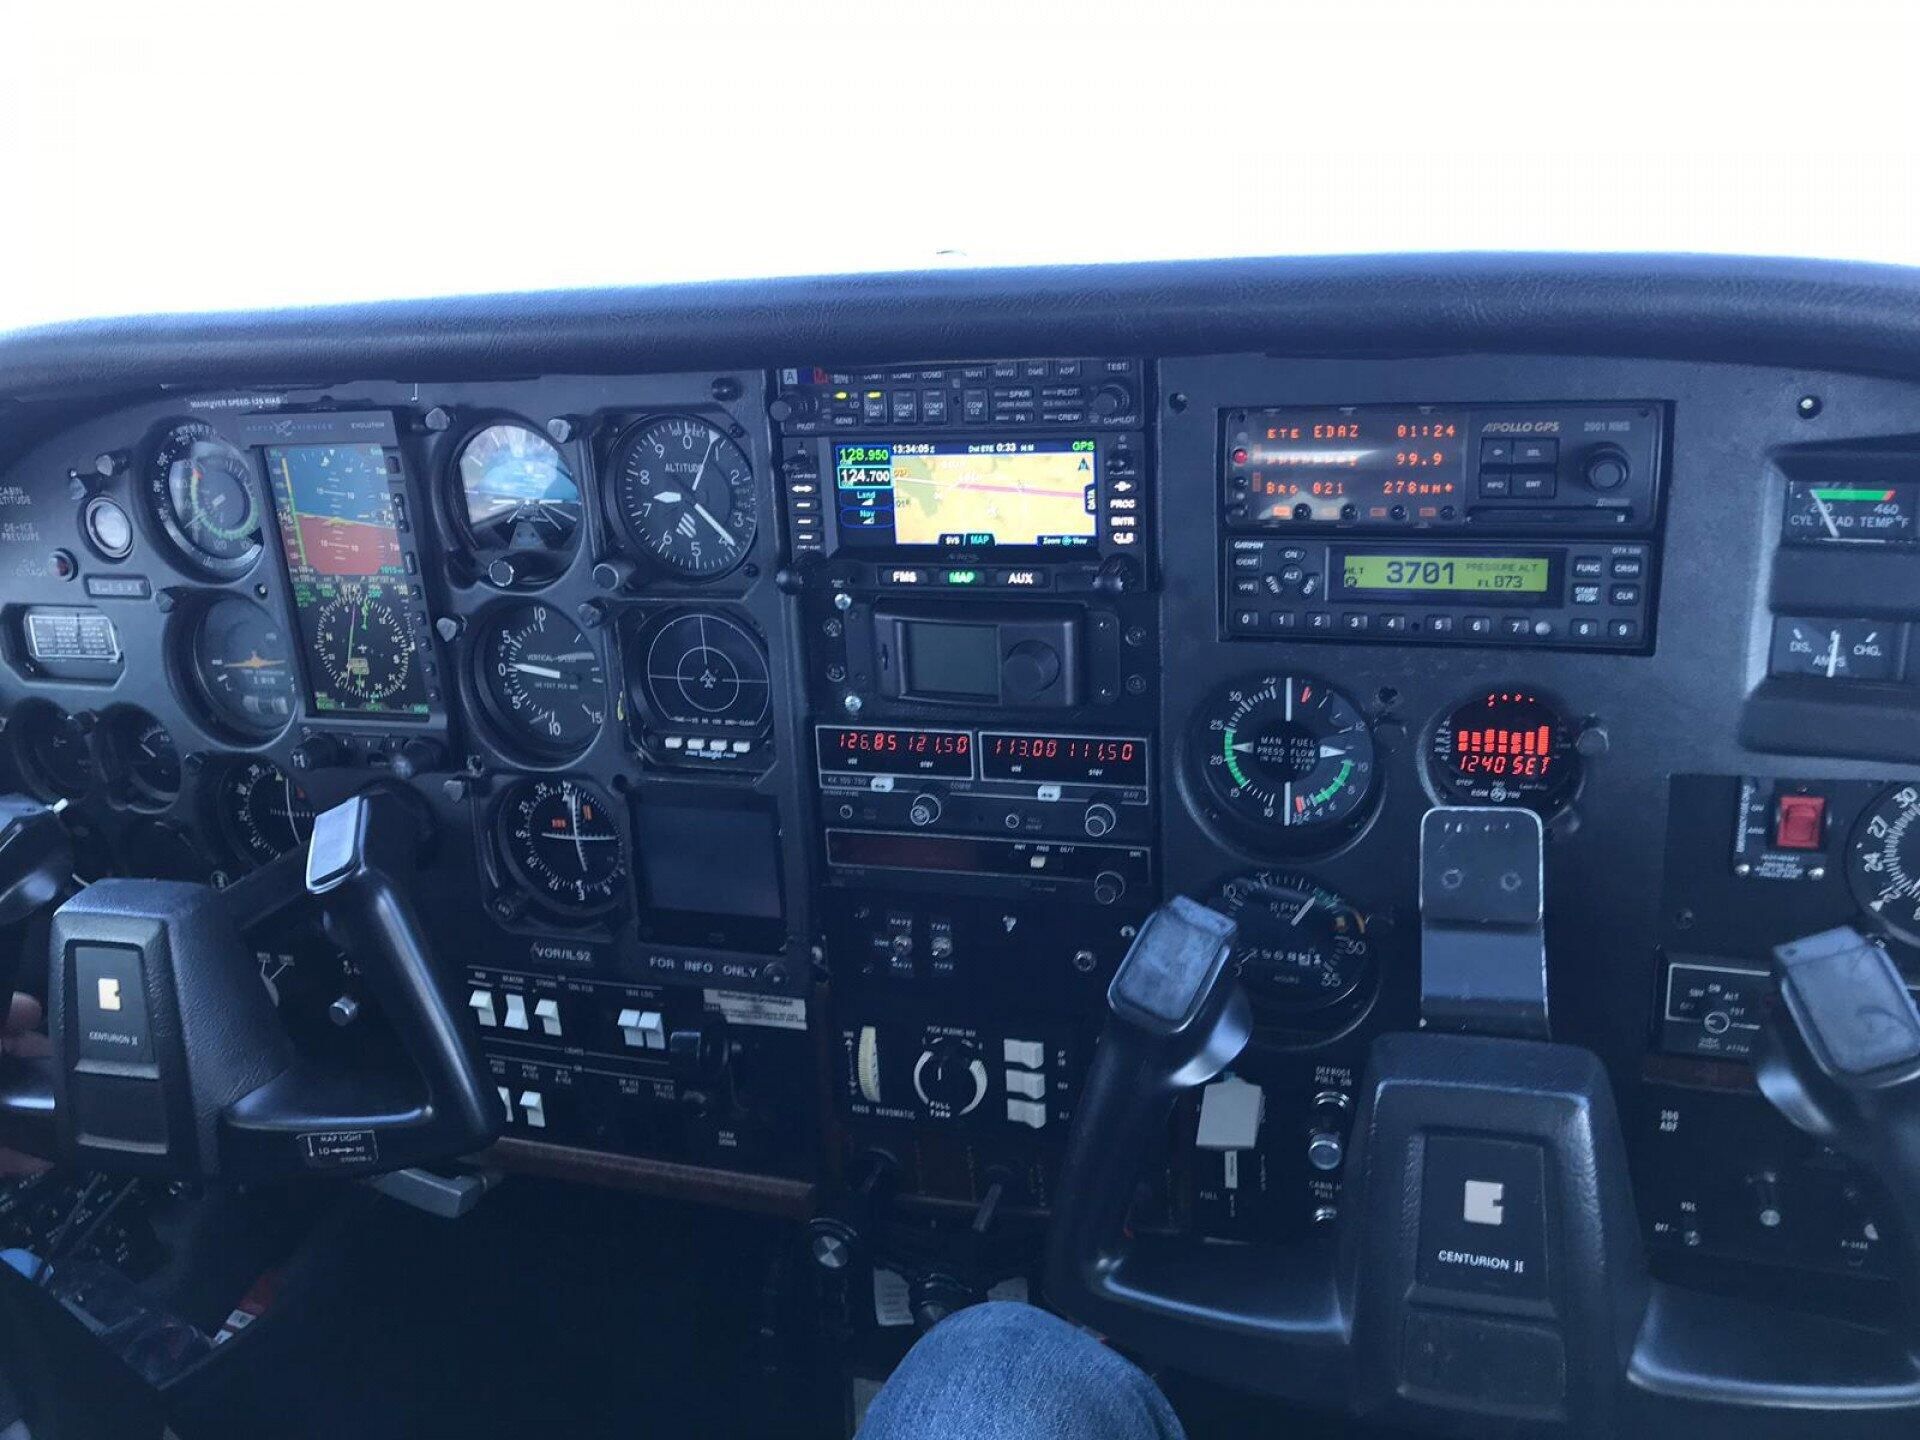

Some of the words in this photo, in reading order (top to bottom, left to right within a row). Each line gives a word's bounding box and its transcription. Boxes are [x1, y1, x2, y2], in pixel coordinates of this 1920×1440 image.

[1313, 424, 1358, 438] EDAZ
[1397, 424, 1455, 438] 01:24
[1482, 422, 1532, 432] APOLLO
[1534, 421, 1560, 432] GPS
[683, 434, 692, 450] 0
[1072, 441, 1094, 452] GPS
[655, 444, 664, 458] 9
[893, 444, 929, 454] 13:34:05
[840, 448, 889, 462] 128.950
[640, 470, 650, 485] 8
[731, 470, 740, 485] 2
[841, 469, 890, 482] 124.700
[643, 503, 652, 517] 7
[1874, 504, 1899, 515] 460
[734, 512, 744, 528] 3
[1790, 515, 1812, 526] CYL
[663, 530, 672, 545] 6
[970, 536, 990, 544] MAP
[691, 542, 701, 556] 5
[1235, 541, 1264, 550] GARMIN
[1386, 561, 1454, 585] 3701
[1466, 563, 1514, 572] PRESSURE
[1518, 564, 1538, 572] ALT
[1576, 564, 1600, 572] FUNC
[1615, 564, 1638, 573] CRSR
[893, 571, 917, 583] FMS
[949, 572, 975, 584] MAP
[1008, 572, 1034, 584] AUX
[1284, 572, 1298, 580] ALT
[1303, 578, 1315, 594] OFF
[1616, 592, 1634, 600] CLR
[534, 606, 546, 621] 10
[1242, 614, 1249, 624] 0
[1279, 616, 1285, 625] 1
[1314, 616, 1322, 626] 2
[1351, 618, 1358, 627] 3
[1387, 618, 1395, 628] 4
[1435, 620, 1442, 630] 5
[1473, 620, 1480, 630] 6
[1512, 622, 1520, 632] 7
[1580, 624, 1588, 634] 8
[1619, 625, 1627, 636] 9
[502, 630, 511, 644] 5
[527, 654, 554, 662] VERTICAL
[1812, 654, 1846, 667] AMS
[498, 663, 506, 676] 0
[512, 696, 522, 710] 5
[591, 711, 602, 724] 15
[549, 723, 562, 736] 10
[1210, 719, 1224, 730] 25
[840, 732, 896, 751] 126.85
[908, 734, 968, 754] 121.50
[1260, 736, 1282, 745] MAN
[1290, 738, 1315, 748] FUEL
[995, 738, 1056, 758] 113.00
[1257, 746, 1285, 756] PRESS
[1290, 748, 1316, 756] FLOW
[1210, 754, 1223, 766] 20
[1460, 756, 1506, 774] 1240
[1512, 756, 1550, 774] SET
[1892, 787, 1918, 809] 30
[1264, 808, 1274, 818] 10
[1866, 815, 1888, 838] 27
[1862, 852, 1884, 872] 24
[1270, 902, 1299, 912] RPM
[650, 956, 675, 970] FOR
[684, 960, 714, 974] INFO
[722, 964, 758, 978] ONLY
[1660, 1122, 1678, 1132] ADF
[318, 1146, 330, 1156] LO
[1438, 1250, 1510, 1271] CENTURION
